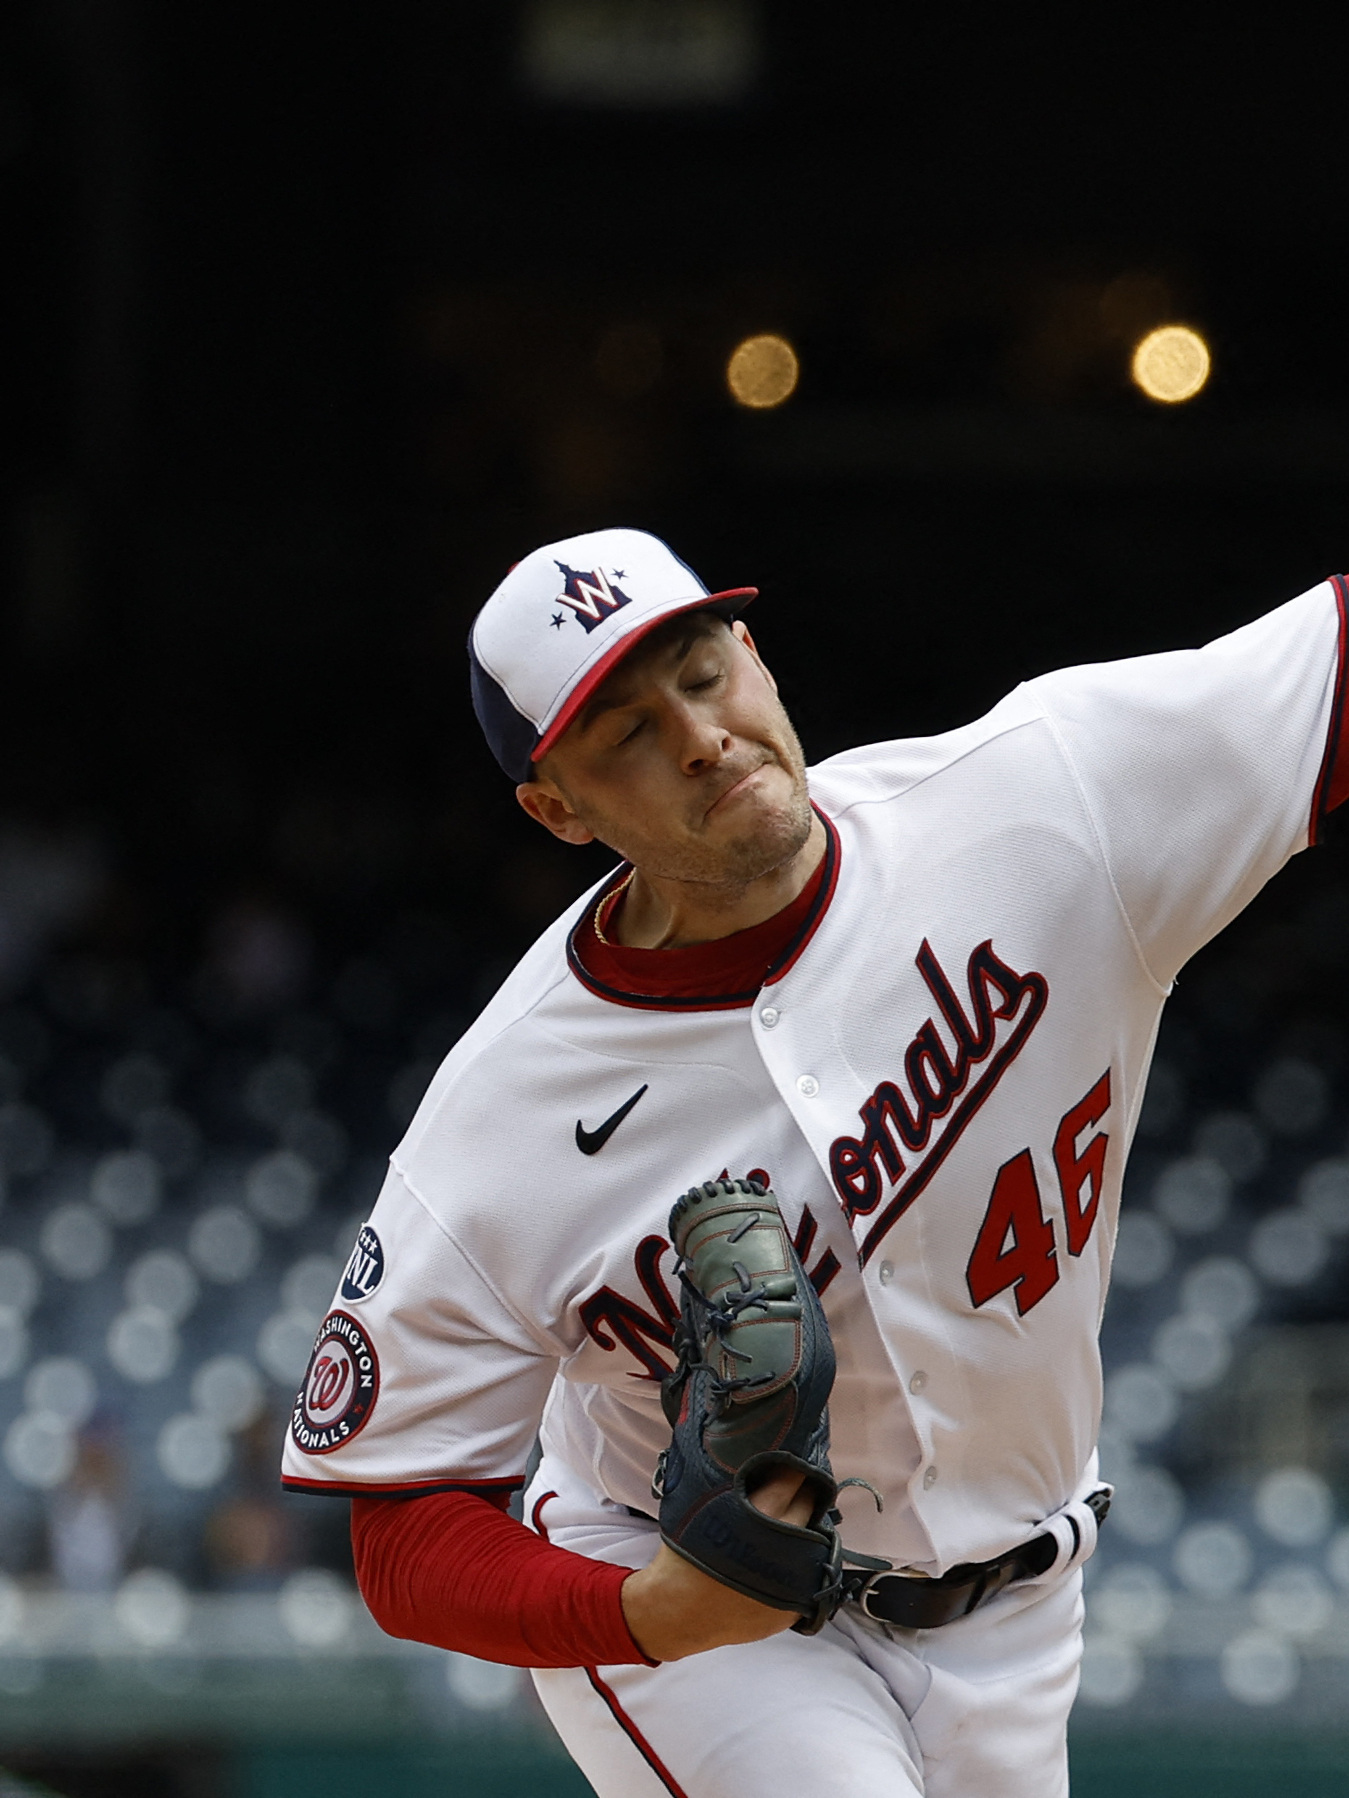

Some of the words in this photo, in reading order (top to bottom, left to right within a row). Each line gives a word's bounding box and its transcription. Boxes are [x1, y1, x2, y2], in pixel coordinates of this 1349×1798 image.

[556, 567, 620, 621] W
[578, 938, 1048, 1382] Nonals
[966, 1068, 1111, 1318] 46
[309, 1356, 349, 1411] W
